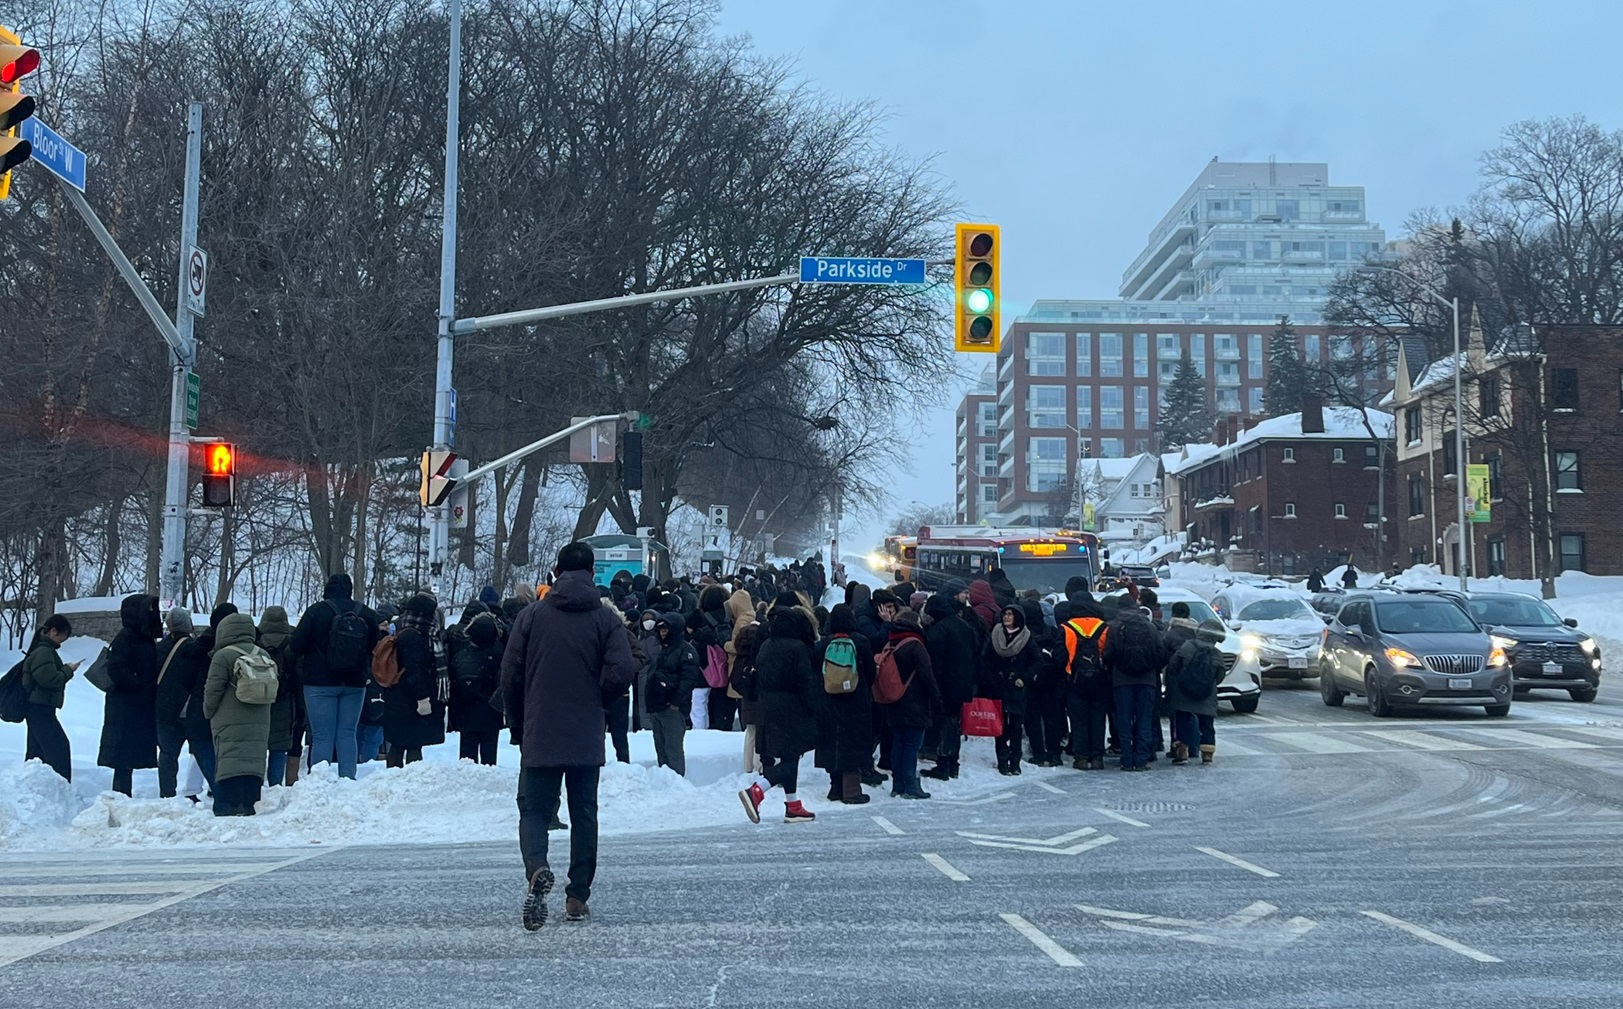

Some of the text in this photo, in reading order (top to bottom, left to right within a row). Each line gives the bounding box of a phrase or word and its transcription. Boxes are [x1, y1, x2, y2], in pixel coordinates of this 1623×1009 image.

[33, 122, 58, 162] Bloor
[65, 146, 73, 173] W
[817, 260, 908, 278] Parkside Dr
